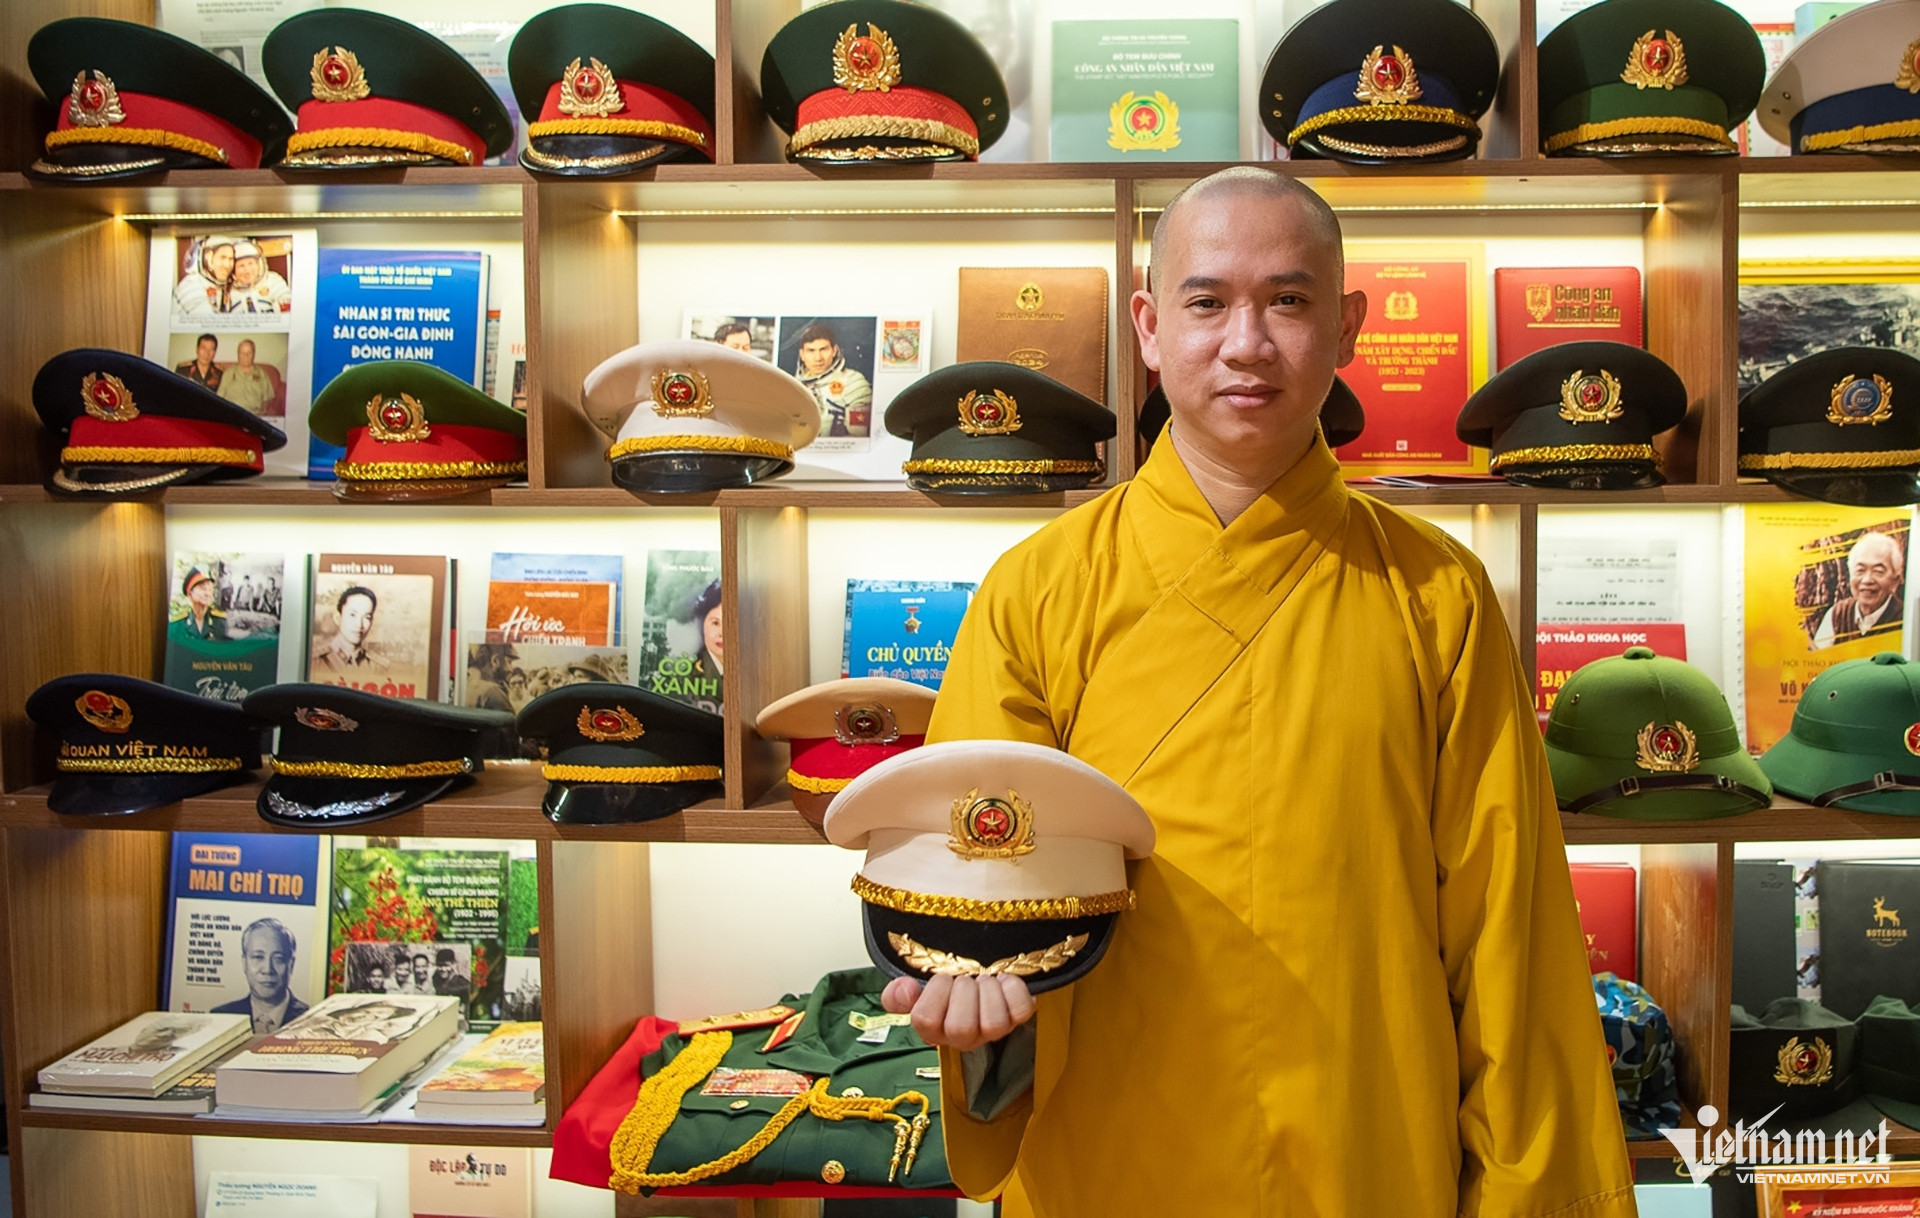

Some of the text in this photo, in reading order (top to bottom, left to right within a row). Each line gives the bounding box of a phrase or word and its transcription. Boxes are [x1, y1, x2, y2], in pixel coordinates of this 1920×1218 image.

[1074, 61, 1215, 74] CÔNG AN NHÂN DÂN VIỆT NAM
[1594, 288, 1612, 303] an
[551, 635, 586, 647] TRANH
[1553, 630, 1586, 643] THẢO
[1587, 633, 1621, 643] KHOA
[1622, 633, 1647, 645] HỌC
[867, 642, 900, 663] CHỦ
[192, 661, 223, 672] NGUYỄN
[659, 651, 693, 676] CỎ
[911, 669, 929, 682] Việt
[930, 669, 946, 680] Na
[651, 677, 718, 697] XANH
[70, 745, 111, 758] QUAN
[163, 745, 209, 758] NAM
[189, 869, 304, 900] MAI CHÍ THỌ
[443, 897, 465, 908] THẾ
[466, 897, 499, 910] THIỆN
[1866, 929, 1908, 938] NOTEBOOK
[495, 1164, 507, 1176] DO
